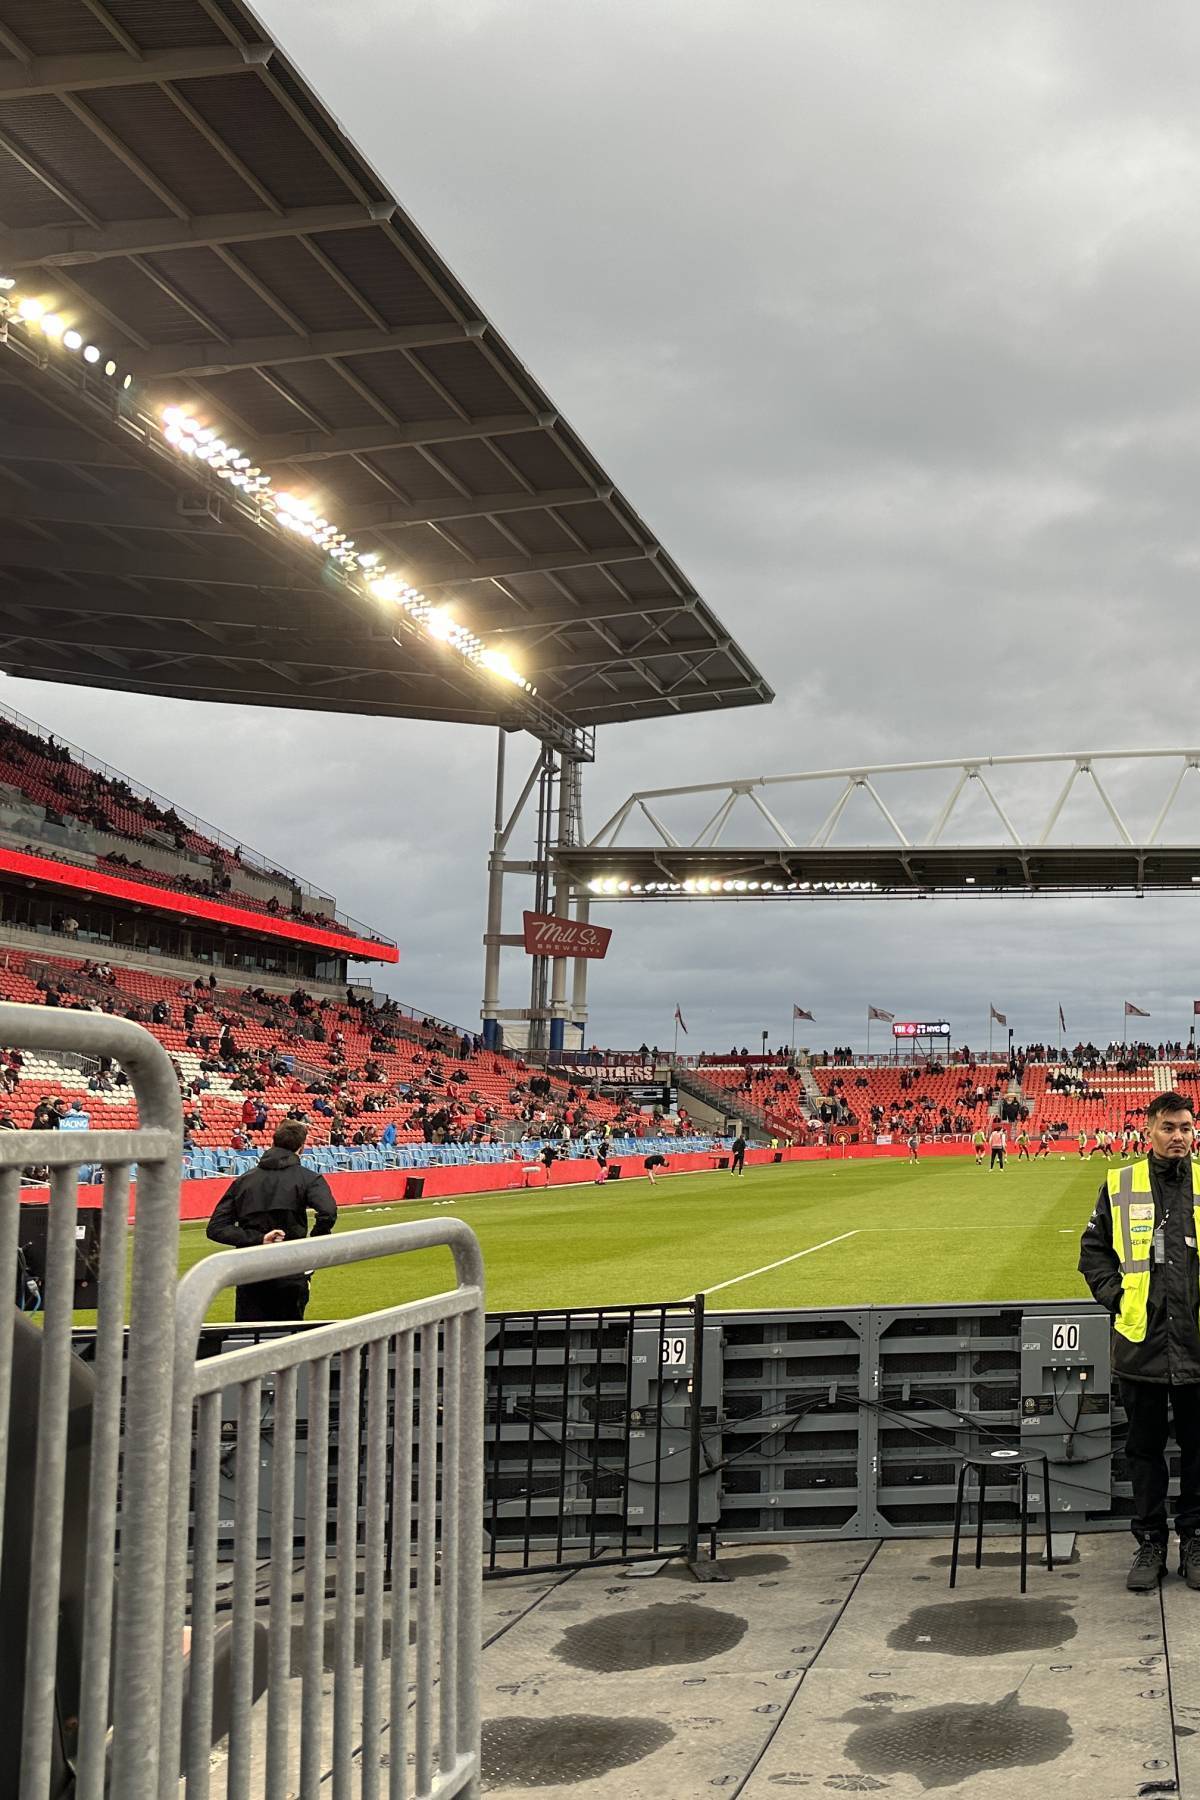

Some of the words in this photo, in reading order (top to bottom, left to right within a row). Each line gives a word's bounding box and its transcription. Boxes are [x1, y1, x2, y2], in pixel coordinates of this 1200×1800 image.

[532, 922, 577, 943] Mill
[578, 929, 601, 945] St.
[537, 943, 594, 952] BREWERY
[576, 1065, 654, 1081] FORTRESS
[1054, 1325, 1078, 1349] 60
